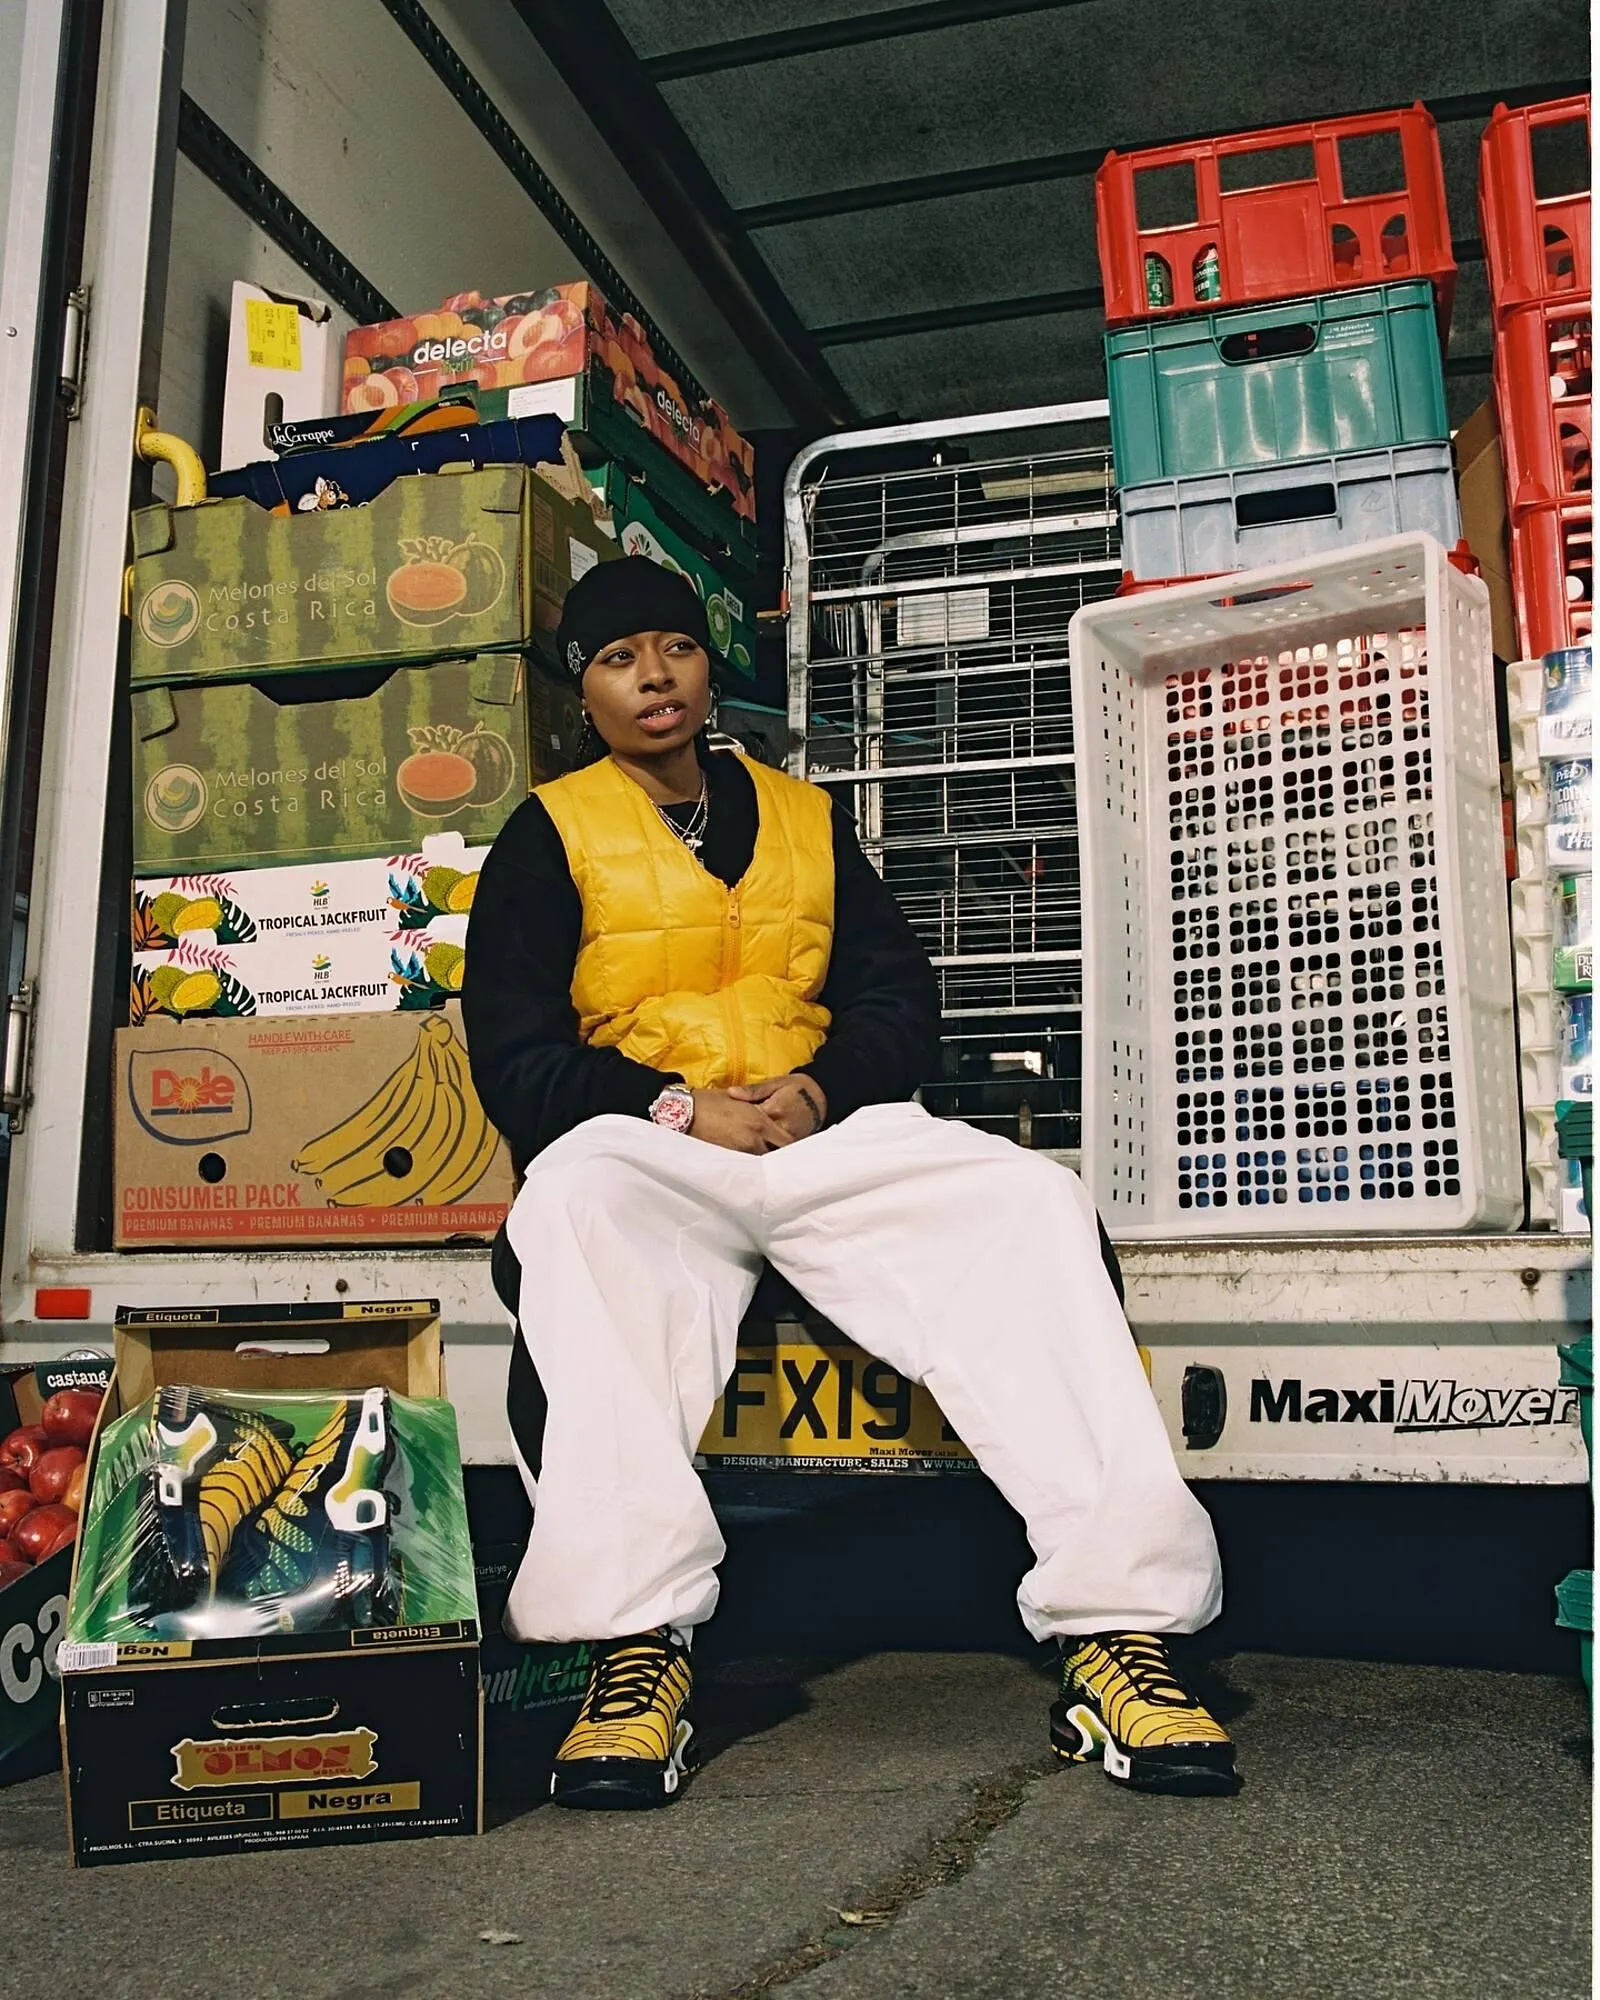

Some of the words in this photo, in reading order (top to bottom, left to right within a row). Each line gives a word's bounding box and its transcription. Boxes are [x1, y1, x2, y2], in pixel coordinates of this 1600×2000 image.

[413, 330, 507, 364] delecta
[657, 390, 700, 444] delecta
[209, 582, 298, 602] Melones
[347, 567, 377, 587] Sol
[206, 608, 291, 632] Costa
[310, 600, 377, 620] Rica
[215, 767, 308, 788] Melones
[314, 760, 346, 780] del
[356, 757, 387, 777] Sol
[213, 795, 300, 818] Costa
[321, 788, 387, 809] Rica
[313, 897, 329, 907] HLB
[258, 914, 319, 931] TROPICAL
[320, 908, 387, 926] JACKFRUIT
[314, 971, 330, 980] HLB
[258, 988, 319, 1004] TROPICAL
[321, 983, 389, 999] JACKFRUIT
[248, 1032, 291, 1044] HANDLE
[291, 1030, 321, 1042] WITH
[322, 1029, 351, 1041] CARE
[152, 1067, 235, 1109] Dole
[123, 1185, 238, 1211] CONSUMER
[245, 1183, 301, 1209] PACK
[126, 1217, 177, 1232] PREMIUM
[180, 1217, 233, 1231] BANANAS
[250, 1215, 305, 1230] PREMIUM
[308, 1213, 365, 1229] BANANAS
[381, 1212, 439, 1227] PREMIUM
[442, 1210, 505, 1225] BANANAS
[145, 1311, 202, 1322] Etiqueta
[361, 1303, 414, 1315] Negra
[47, 1369, 109, 1388] castang
[723, 1456, 767, 1466] DESIGN
[775, 1457, 862, 1467] MANUFACTURE
[870, 1458, 909, 1468] SALES
[869, 1447, 896, 1456] Maxi
[898, 1447, 934, 1456] Mover
[373, 1625, 441, 1641] Etiqueta
[203, 1744, 351, 1776] OLMOS
[157, 1801, 247, 1822] Etiqueta
[308, 1791, 392, 1811] Negra
